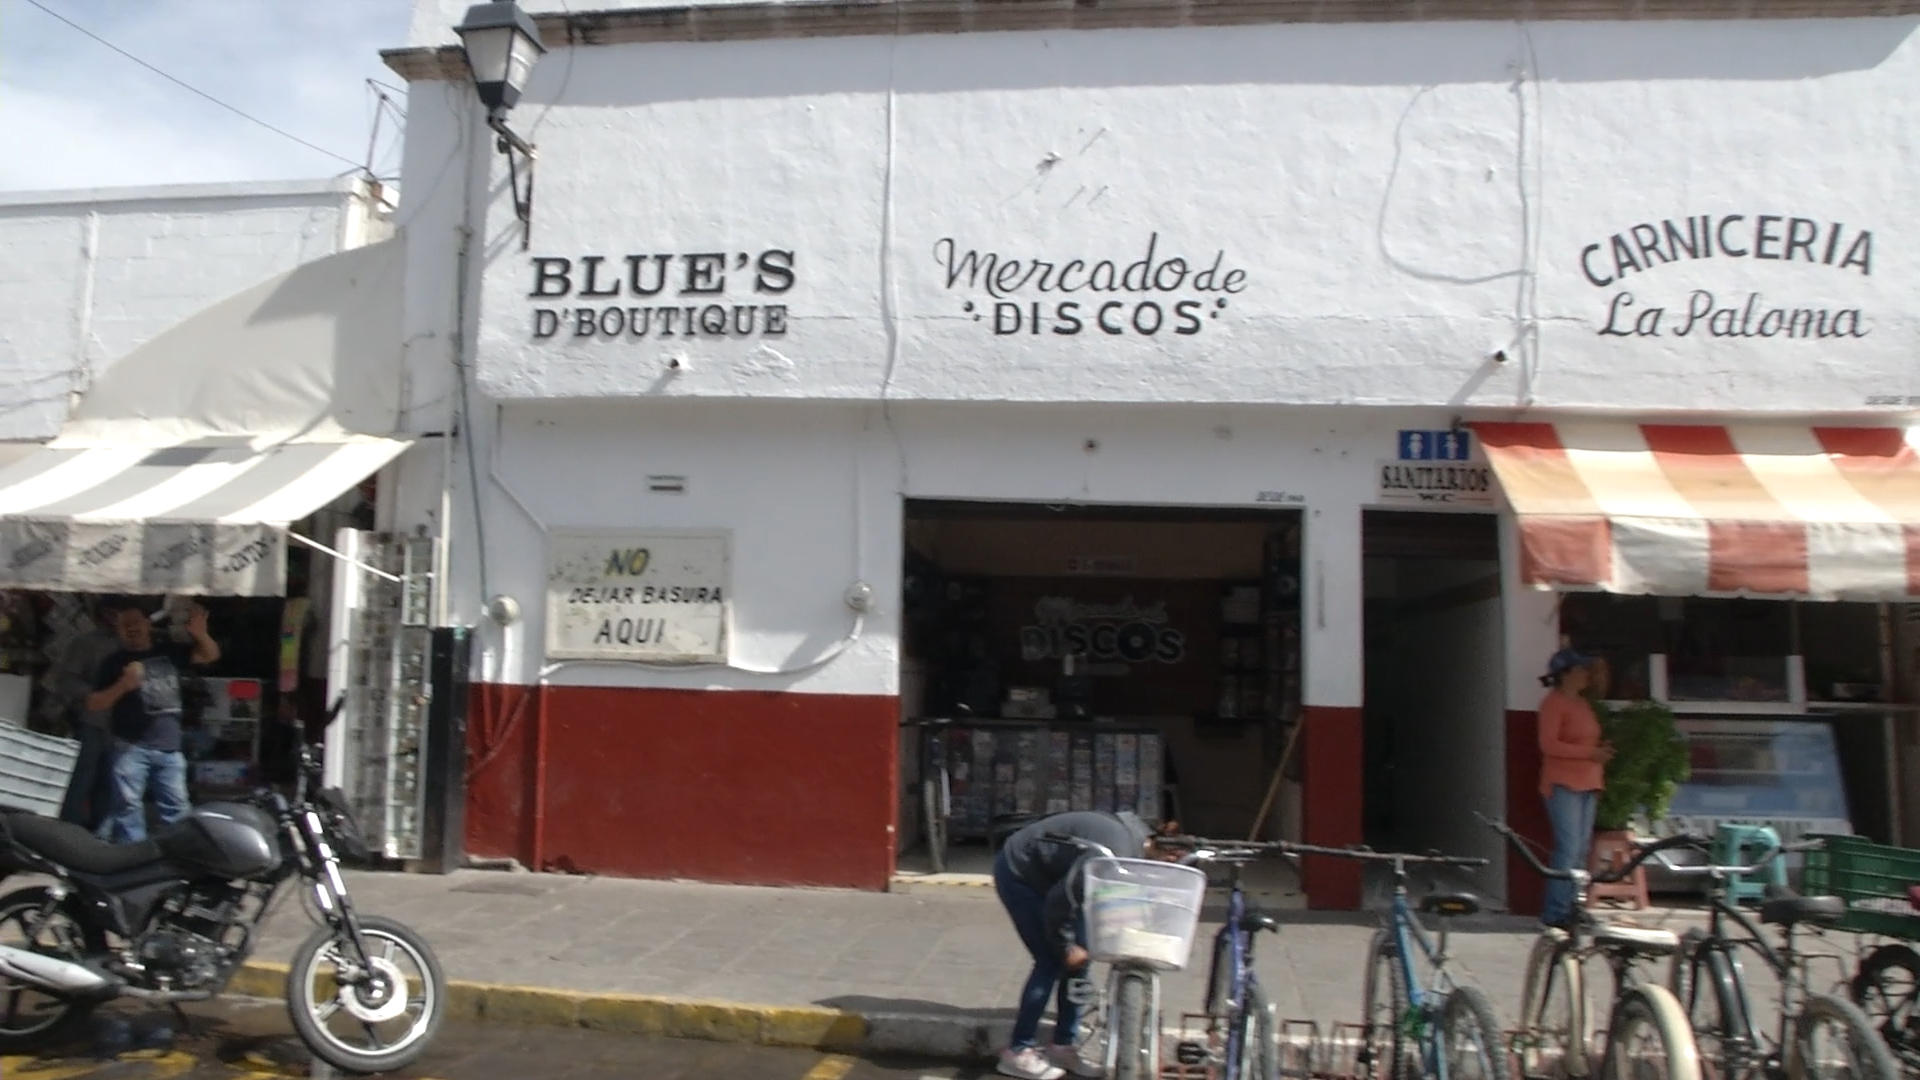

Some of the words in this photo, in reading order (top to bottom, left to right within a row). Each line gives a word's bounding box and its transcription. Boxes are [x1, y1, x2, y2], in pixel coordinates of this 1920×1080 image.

[932, 231, 1193, 299] Mercado
[1193, 250, 1248, 294] de
[1580, 214, 1873, 287] CARNICERIA
[529, 249, 796, 297] BLUE'S
[533, 304, 788, 338] D'BOUTIQUE
[993, 301, 1202, 336] DISCOS
[1598, 291, 1665, 337] La
[1673, 289, 1872, 338] Paloma
[1381, 465, 1490, 492] SANITARIOS
[604, 547, 650, 577] NO
[568, 586, 634, 604] DEJAR
[641, 585, 723, 604] BASURA
[593, 617, 667, 645] AQUI
